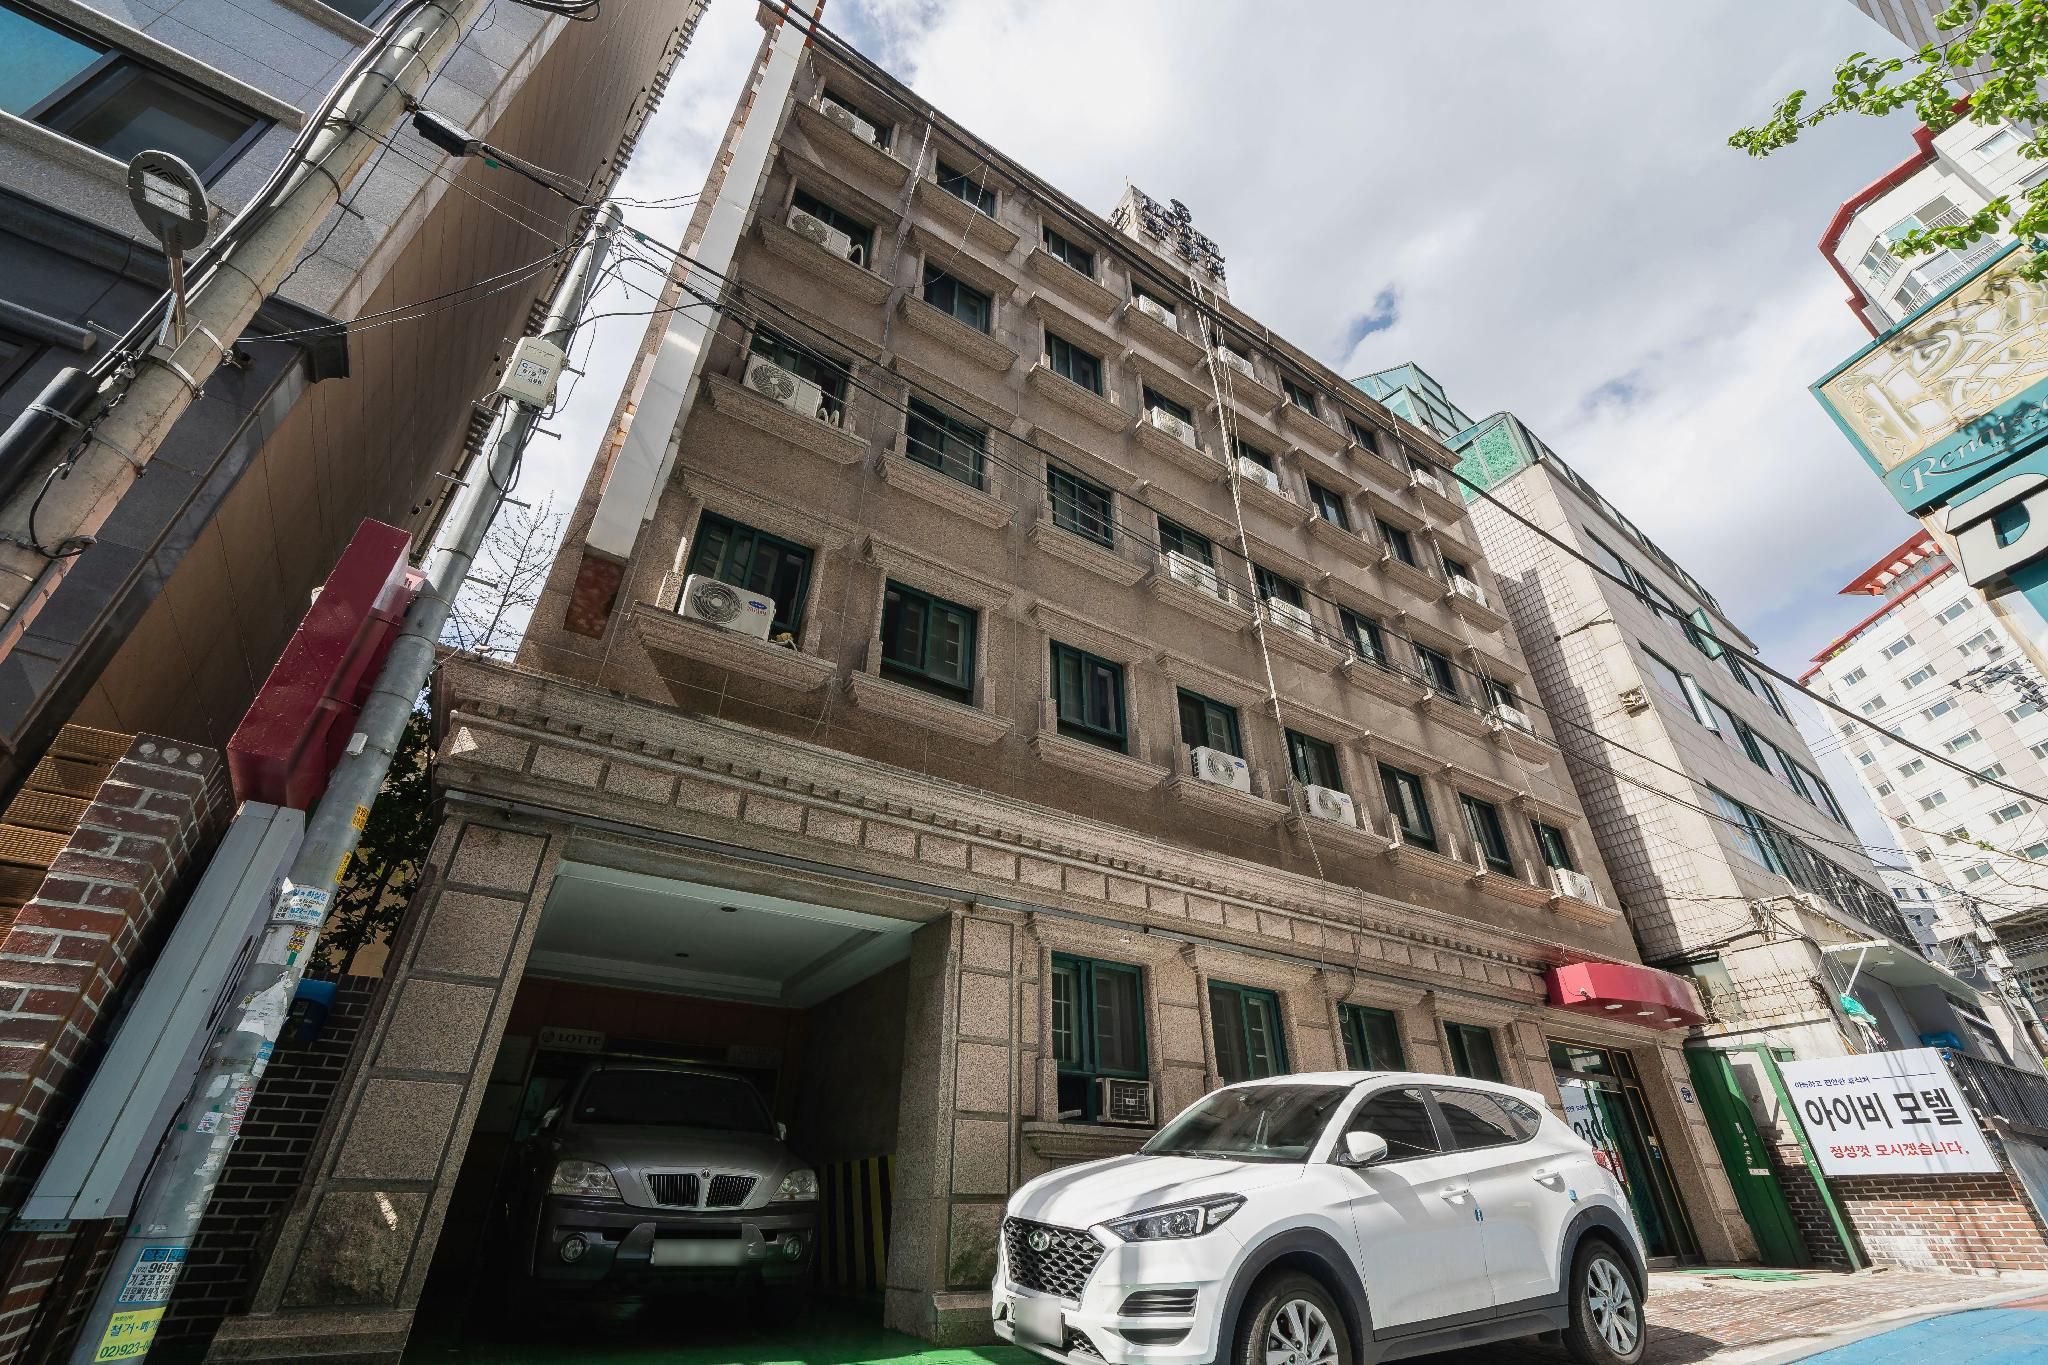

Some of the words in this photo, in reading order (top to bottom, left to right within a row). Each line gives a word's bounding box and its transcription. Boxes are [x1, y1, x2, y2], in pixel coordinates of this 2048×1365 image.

[1805, 1093, 1894, 1132] 아이비
[1893, 1087, 1963, 1126] 모텔
[1829, 1144, 1872, 1159] 정성껏
[1874, 1140, 1970, 1157] 모시겠습니다.
